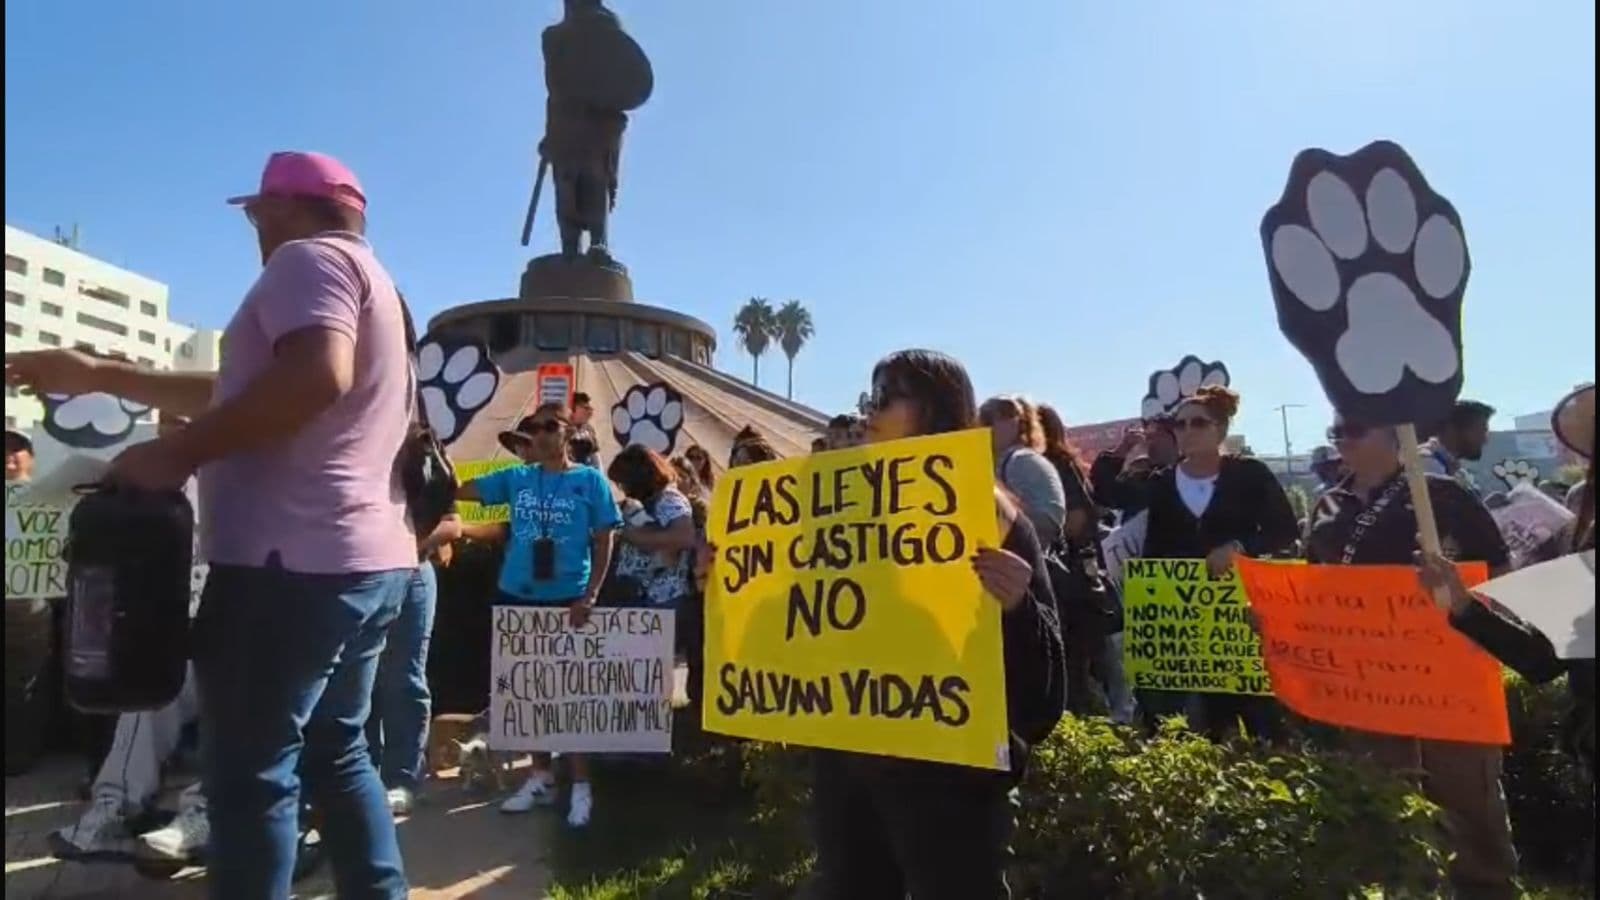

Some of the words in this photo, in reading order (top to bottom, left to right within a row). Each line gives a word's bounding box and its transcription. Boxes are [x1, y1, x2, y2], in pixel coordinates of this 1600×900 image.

[726, 473, 800, 534] LAS
[811, 454, 957, 518] LEYES
[17, 510, 62, 534] VOZ
[724, 540, 774, 593] SIN
[788, 522, 964, 569] CASTIGO
[1128, 560, 1157, 578] MI
[1161, 561, 1200, 581] VOZ
[786, 577, 866, 641] NO
[1176, 585, 1239, 606] VOZ
[627, 611, 662, 635] ESA
[717, 662, 833, 717] SALVAN
[840, 669, 971, 727] VIDAS
[504, 701, 529, 736] AL
